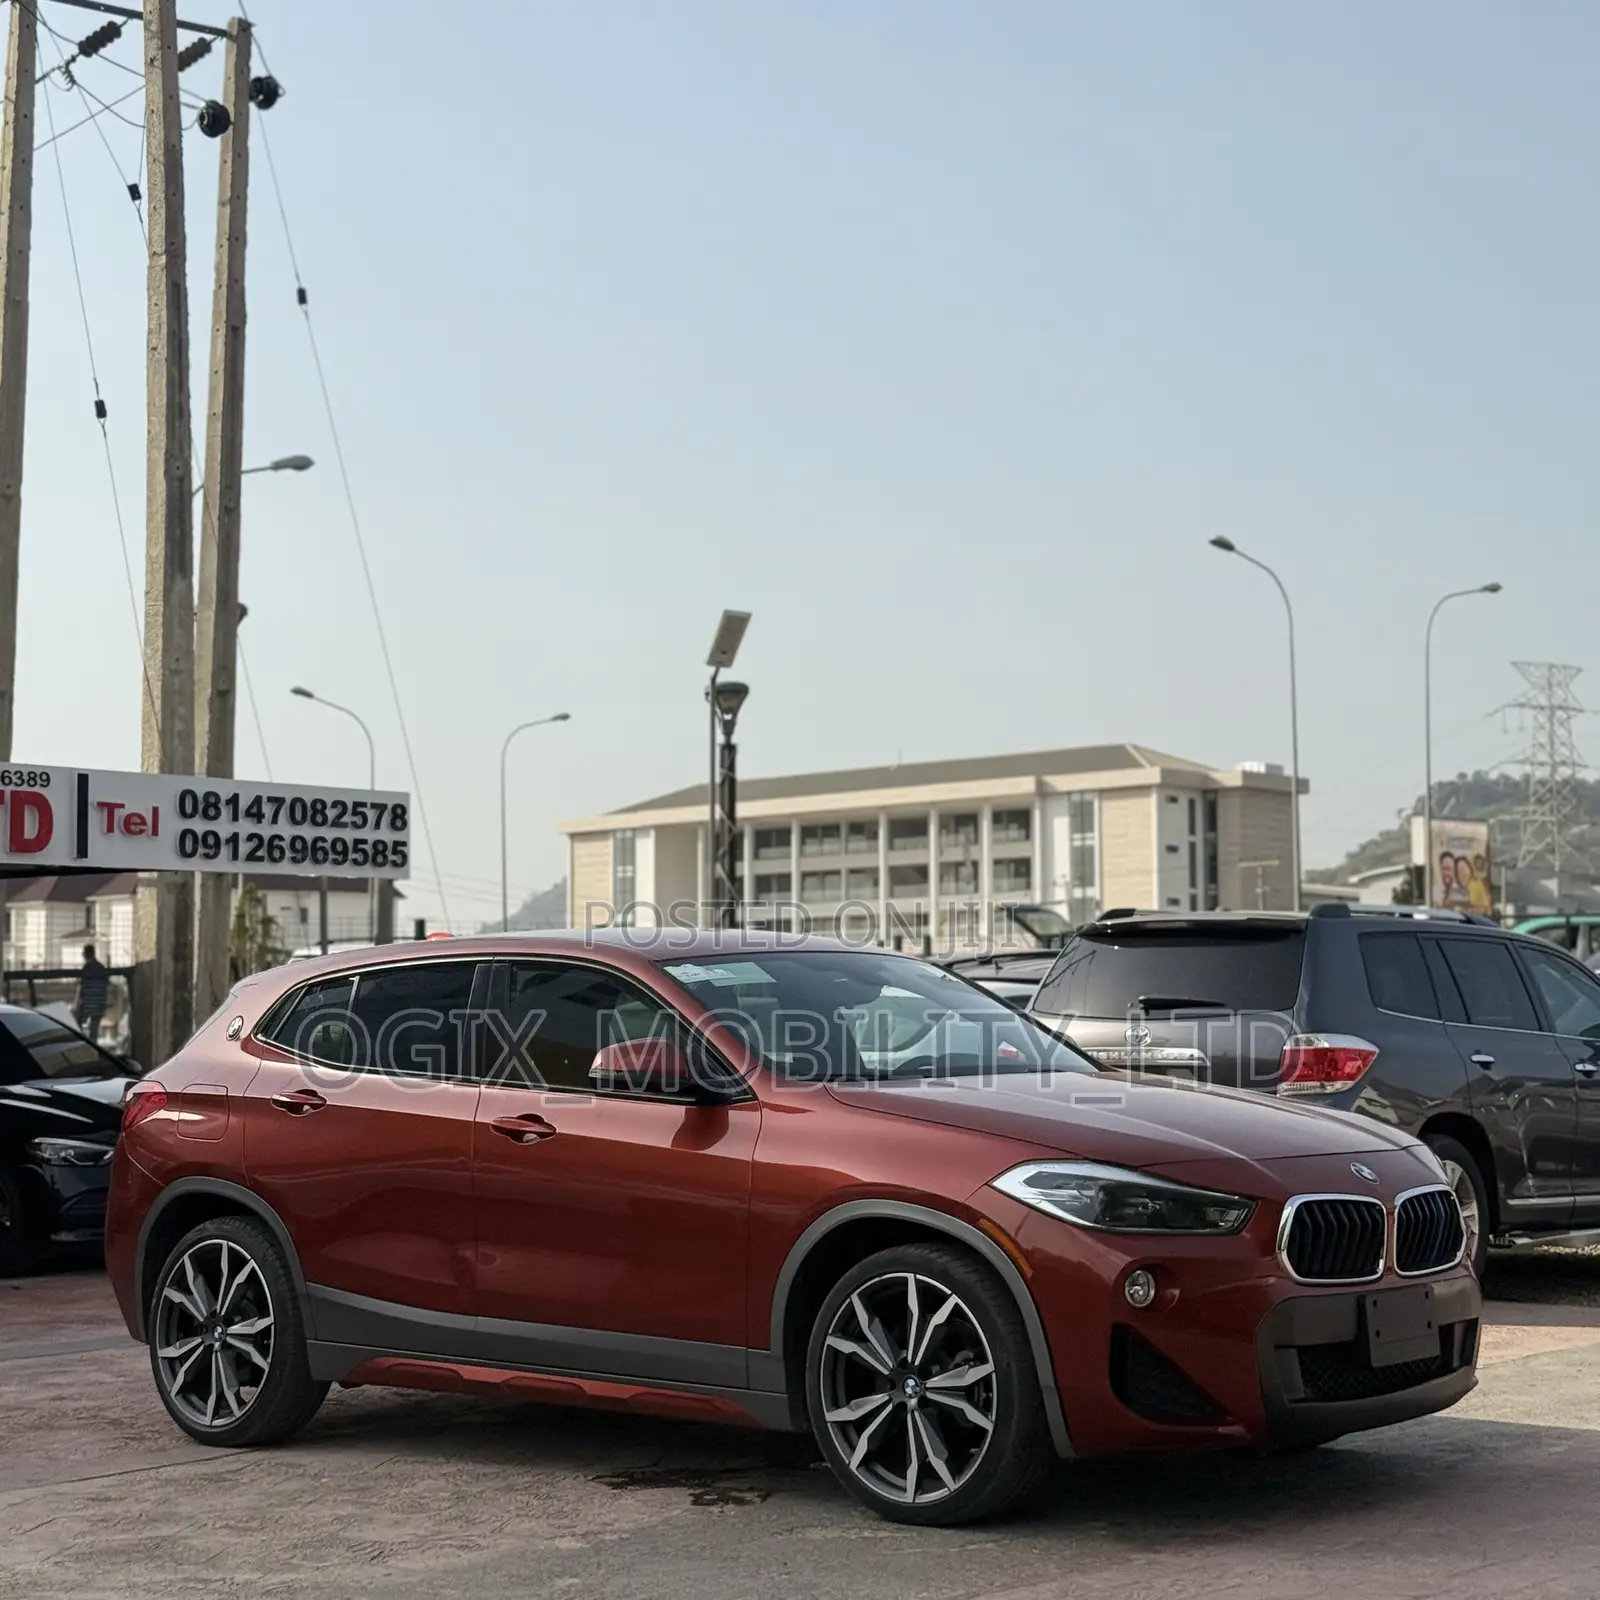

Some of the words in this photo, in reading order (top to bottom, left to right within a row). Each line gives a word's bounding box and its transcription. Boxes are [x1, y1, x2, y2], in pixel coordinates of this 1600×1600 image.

[0, 769, 51, 788] 6389
[0, 790, 54, 853] D
[97, 801, 159, 837] Tel
[178, 789, 408, 831] 08147082578
[178, 829, 408, 868] 09126969585
